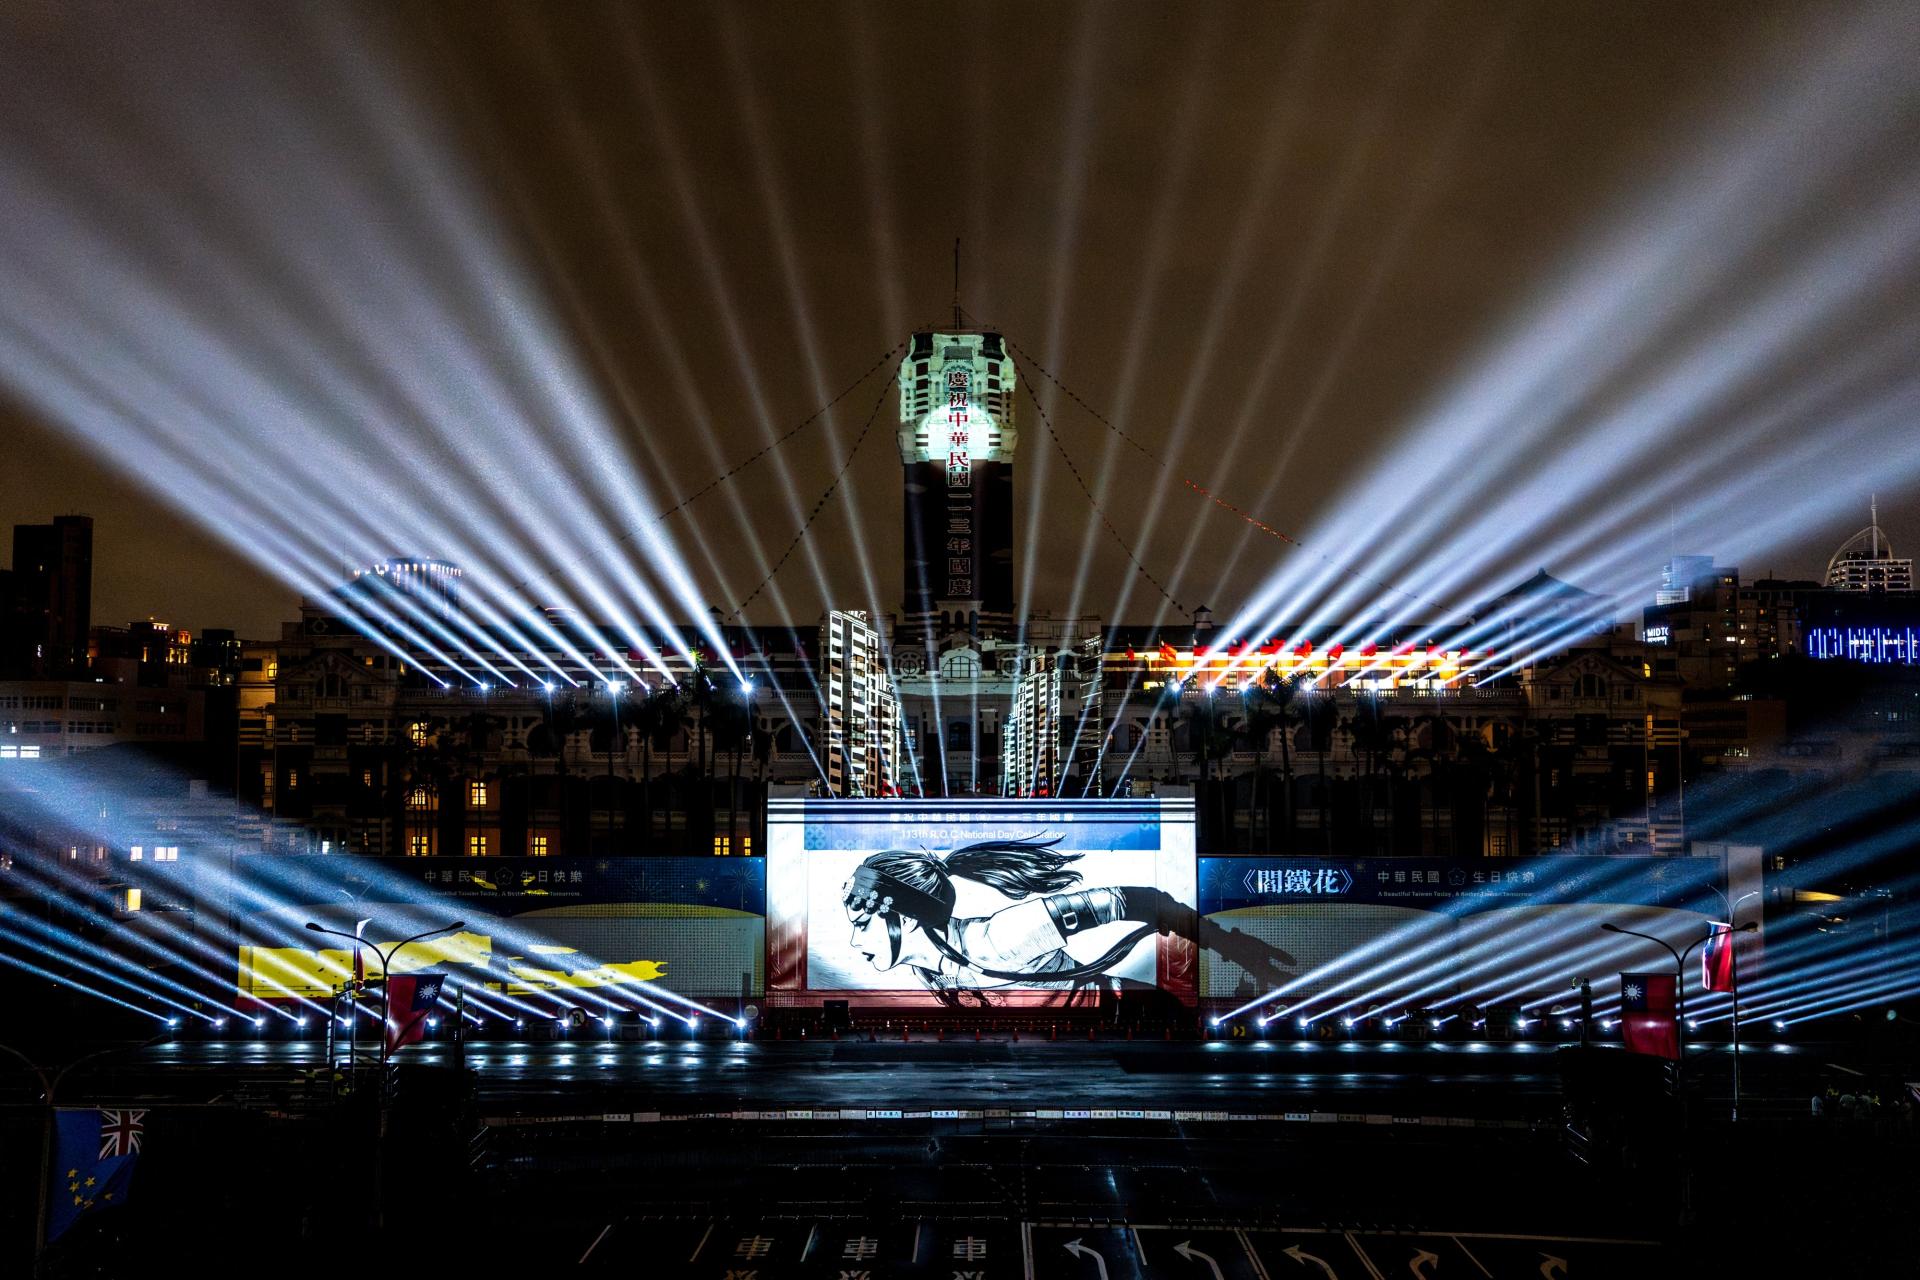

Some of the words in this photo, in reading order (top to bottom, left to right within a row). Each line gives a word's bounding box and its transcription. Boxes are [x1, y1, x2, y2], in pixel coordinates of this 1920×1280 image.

[960, 830, 996, 839] National
[997, 830, 1015, 841] Day
[1377, 870, 1440, 884] 中華民國
[1473, 871, 1535, 884] 生日快樂
[841, 1236, 878, 1261] 車
[953, 1236, 987, 1262] 車
